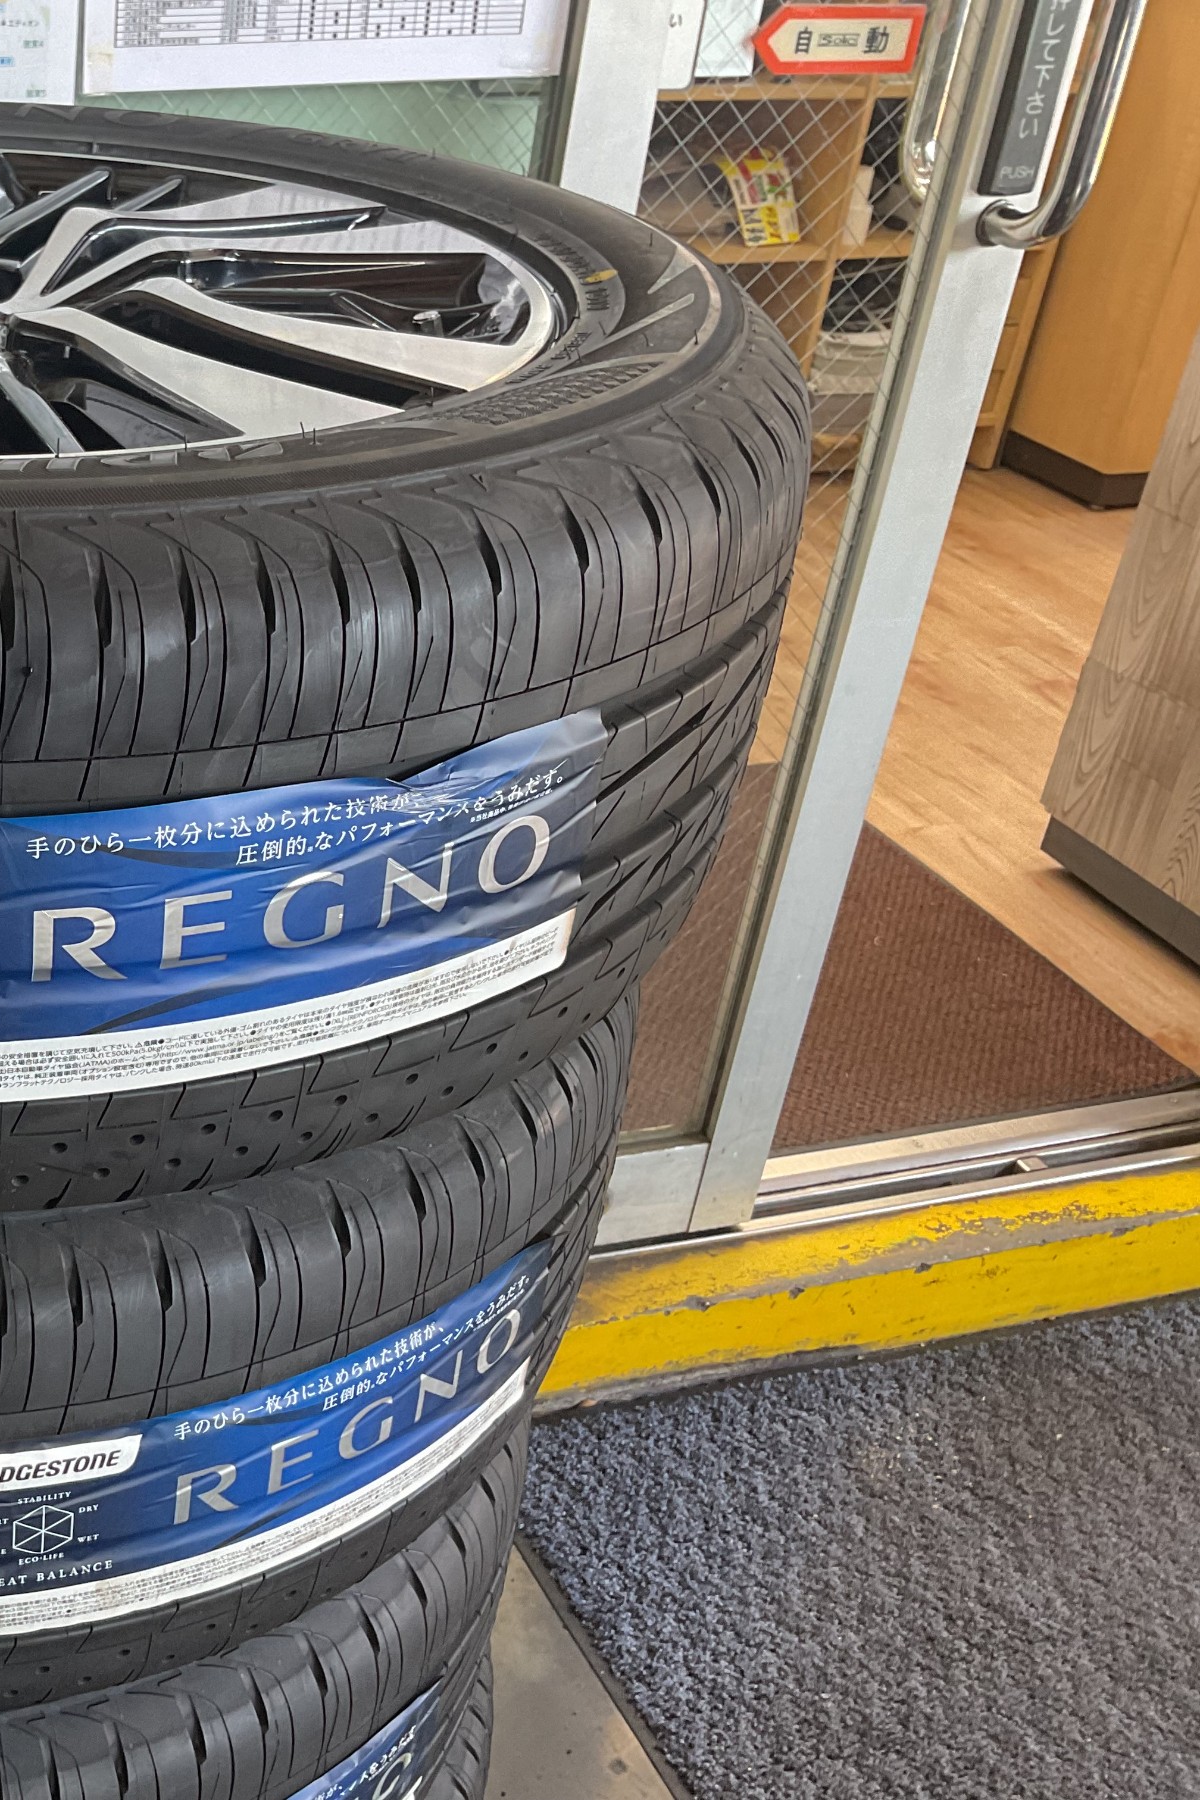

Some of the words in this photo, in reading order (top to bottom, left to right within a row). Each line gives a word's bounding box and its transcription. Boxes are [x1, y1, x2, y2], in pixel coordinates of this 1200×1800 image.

[794, 27, 813, 55] 自
[862, 26, 890, 54] 動
[1000, 164, 1035, 181] PUSH
[31, 814, 551, 983] REGNO
[173, 1323, 446, 1441] 手のひら一枚分に込められた技術が、
[173, 1308, 522, 1525] REGNO
[17, 1491, 72, 1505] STABILITY
[78, 1504, 99, 1513] DRY
[77, 1534, 100, 1543] WET
[36, 1559, 114, 1582] BALANCE
